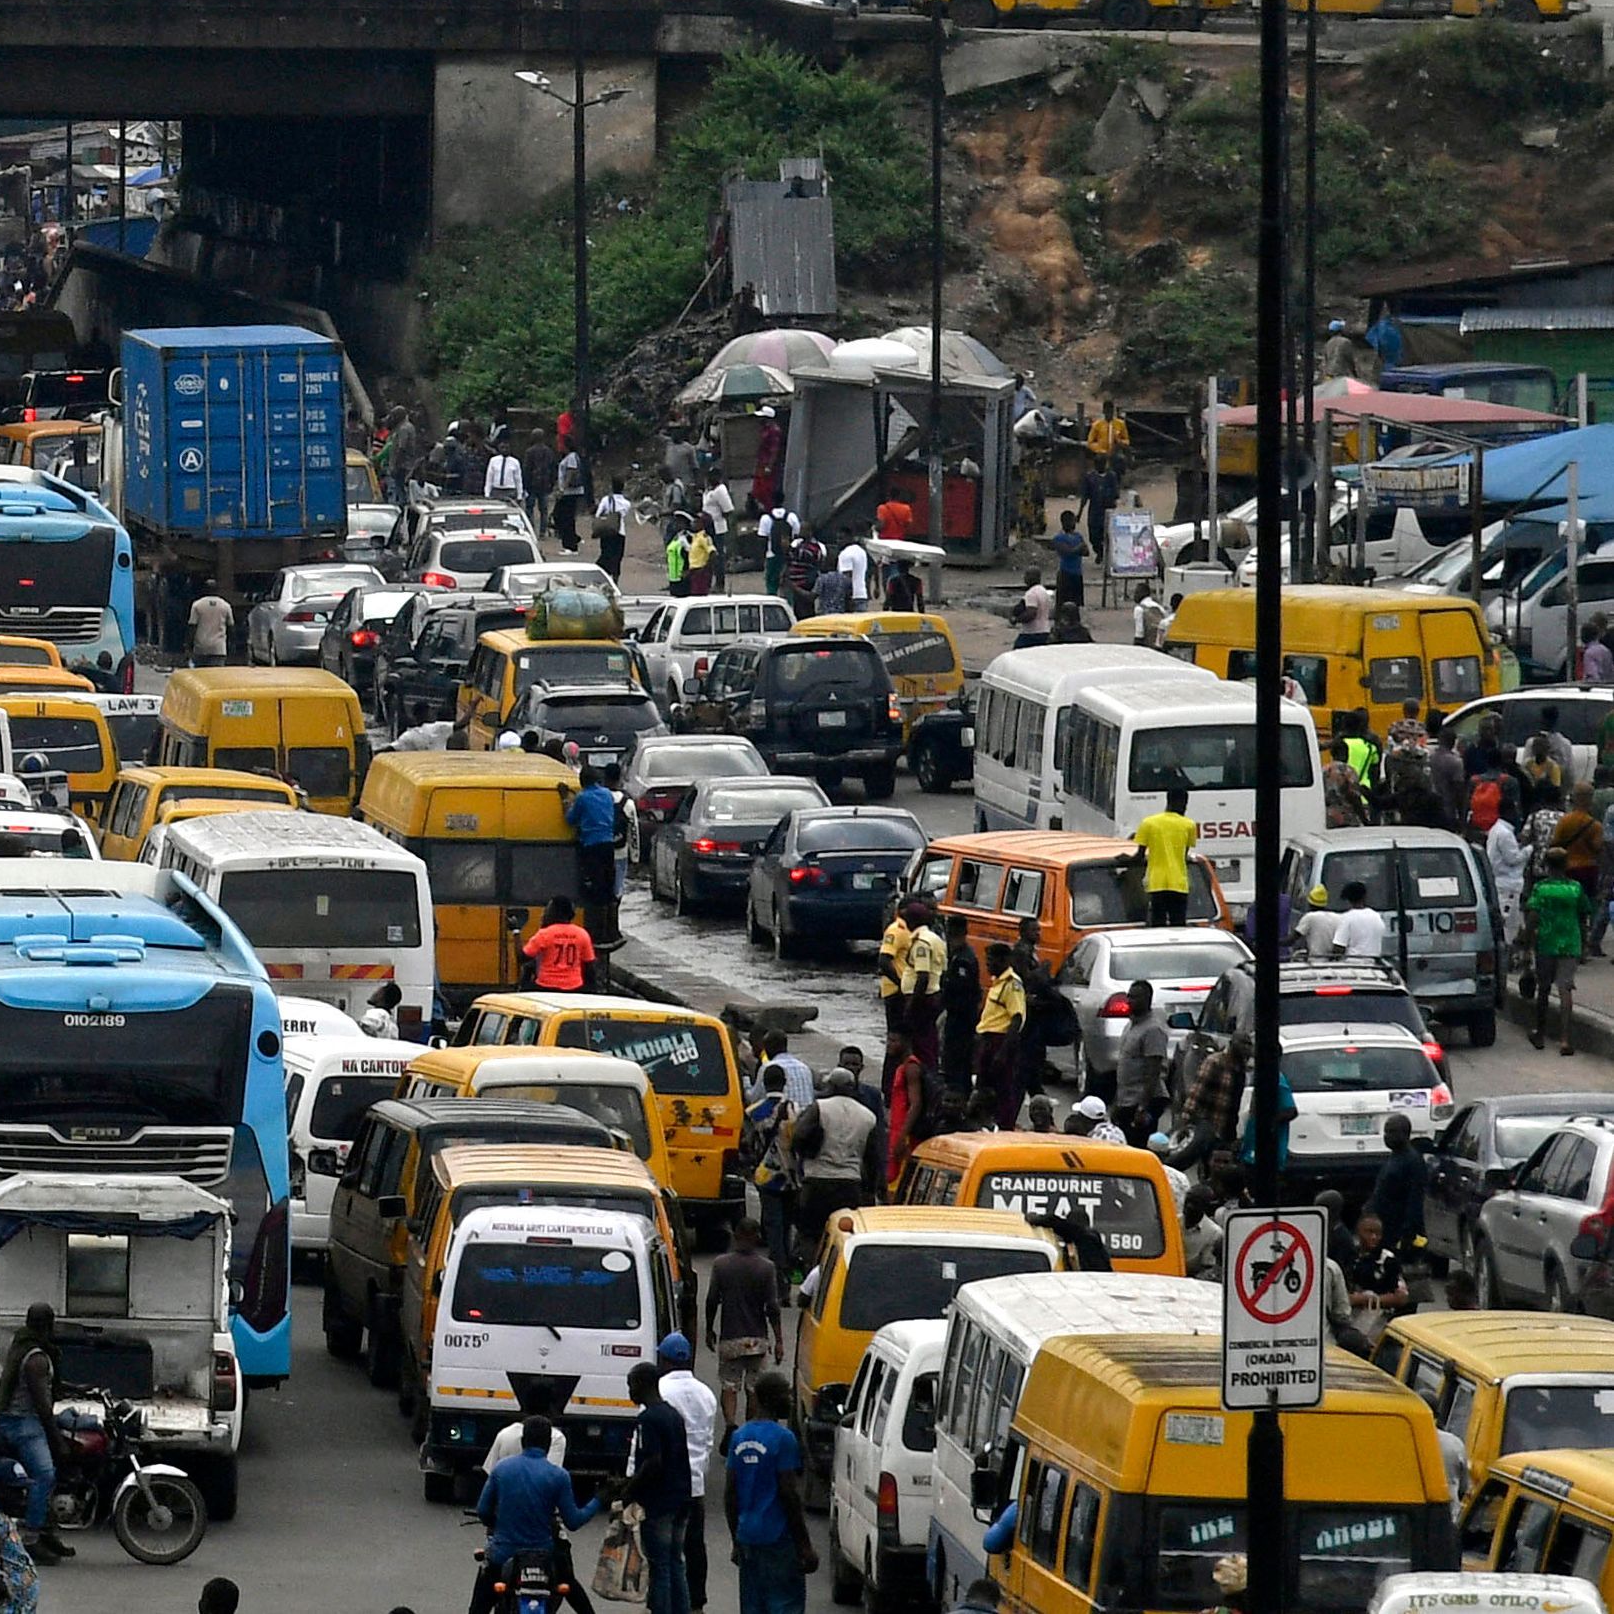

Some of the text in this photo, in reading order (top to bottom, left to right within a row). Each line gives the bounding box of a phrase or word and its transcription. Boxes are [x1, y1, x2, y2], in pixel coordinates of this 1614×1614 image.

[184, 453, 199, 467] A
[108, 699, 139, 711] LAW
[1194, 820, 1258, 840] ISSA
[553, 943, 576, 966] 70
[64, 1014, 126, 1027] 0102189
[281, 1019, 316, 1033] ERRY
[670, 1046, 699, 1066] 100
[342, 1059, 358, 1073] NA
[991, 1176, 1103, 1194] CRANBOURNE
[993, 1194, 1101, 1228] MEAT
[1110, 1234, 1142, 1250] 580
[1245, 1352, 1296, 1368] (OKADA)
[1231, 1370, 1317, 1387] PROHIBITED
